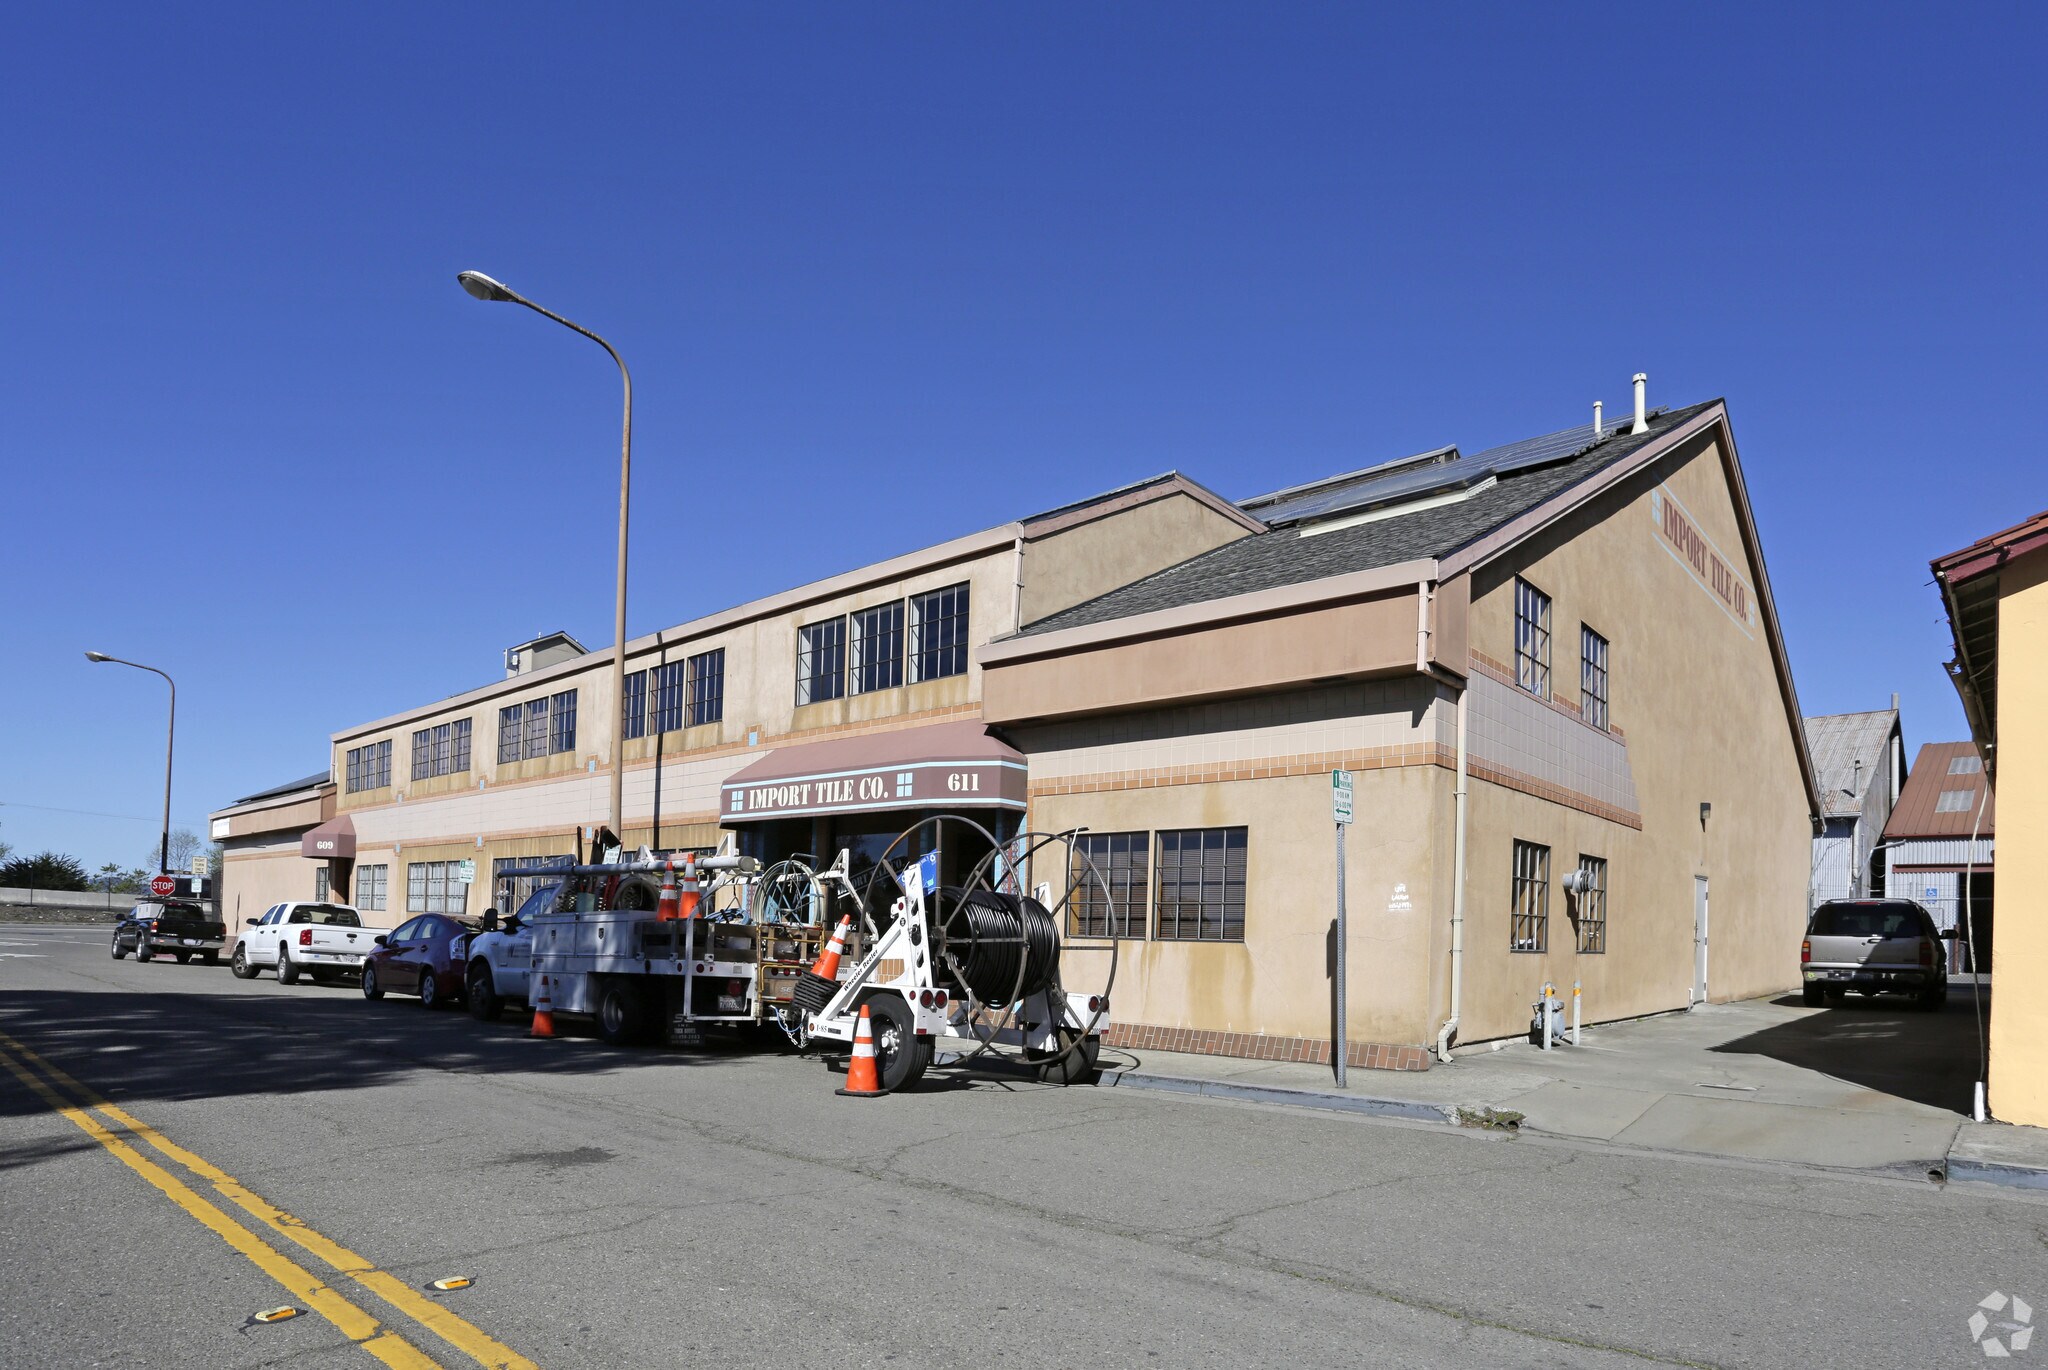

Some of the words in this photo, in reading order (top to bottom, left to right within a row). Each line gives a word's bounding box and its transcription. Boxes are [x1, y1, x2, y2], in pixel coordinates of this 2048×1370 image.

[1663, 496, 1707, 579] IMPORT
[1709, 552, 1732, 606] TILE
[1734, 581, 1747, 622] CO.
[748, 784, 811, 810] IMPORT
[815, 778, 854, 804] TILE
[859, 776, 889, 801] CO.
[947, 773, 980, 792] 611
[316, 841, 334, 850] 609
[152, 881, 174, 889] STOP
[844, 968, 863, 991] Wheeler
[862, 949, 879, 969] Reeler
